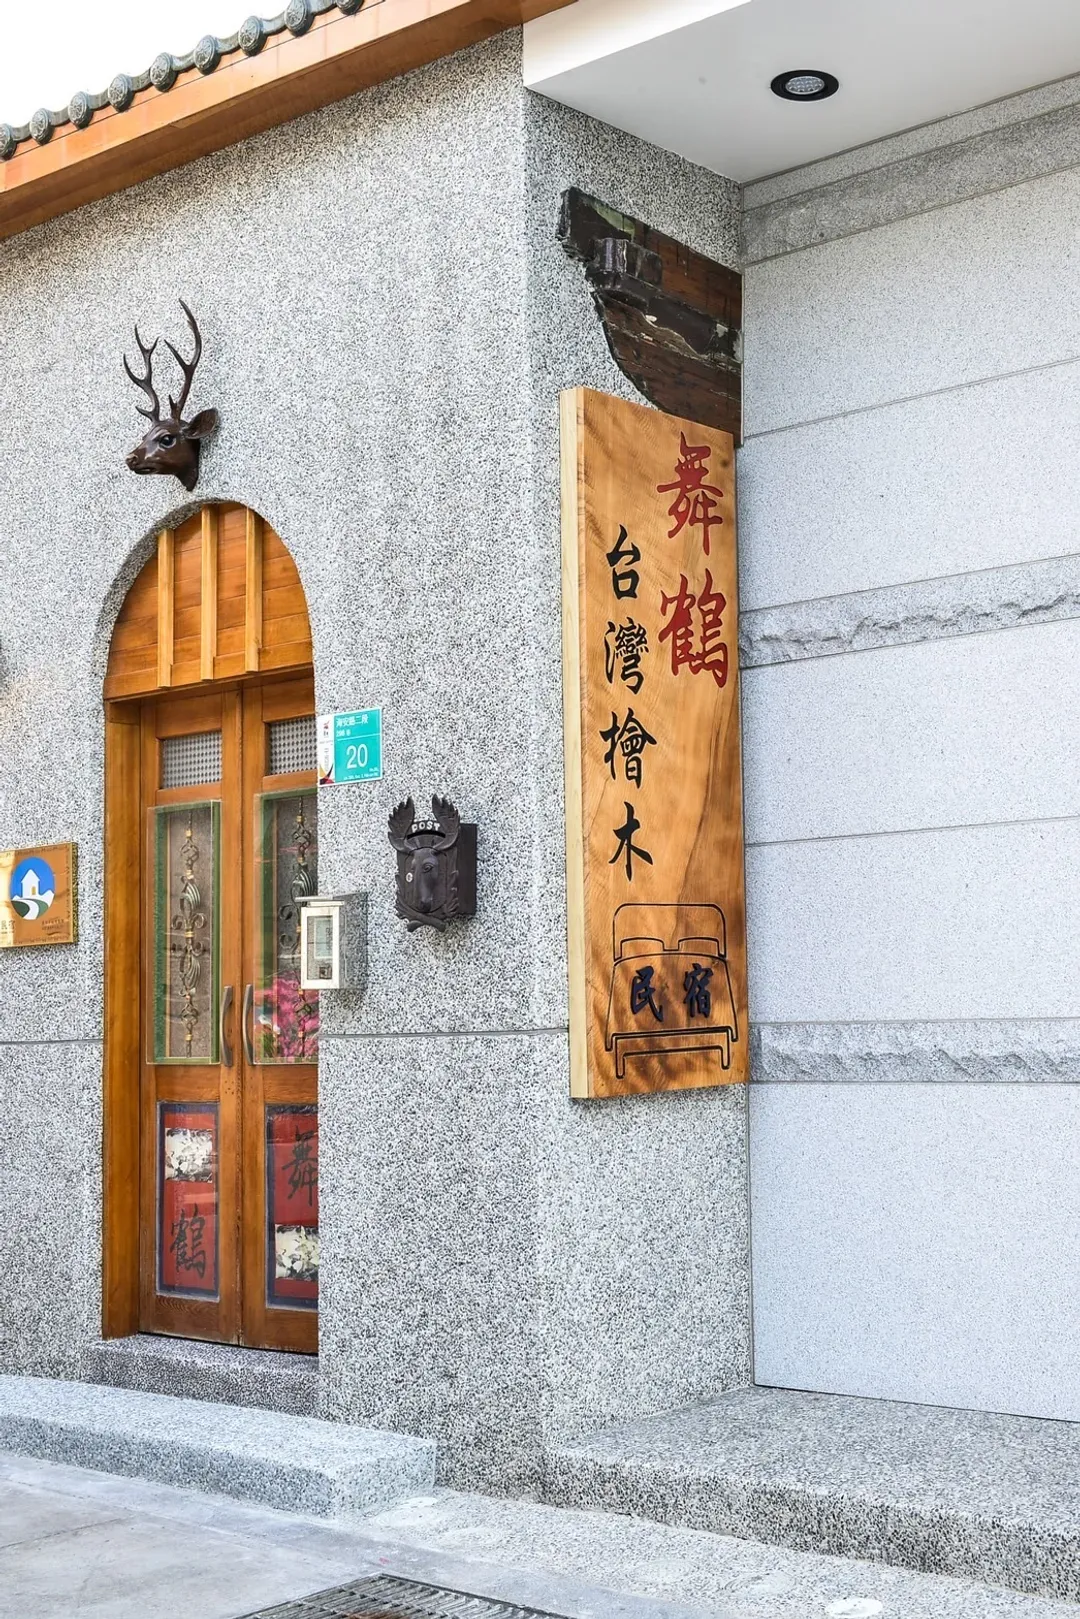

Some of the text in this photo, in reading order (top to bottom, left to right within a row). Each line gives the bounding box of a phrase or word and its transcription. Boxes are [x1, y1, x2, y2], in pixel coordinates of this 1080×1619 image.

[657, 431, 729, 689] 舞鶴
[599, 524, 658, 882] 台灣檜木
[346, 744, 367, 769] 20
[412, 821, 440, 833] POST
[630, 963, 714, 1023] 民宿
[170, 1203, 205, 1278] 鶴
